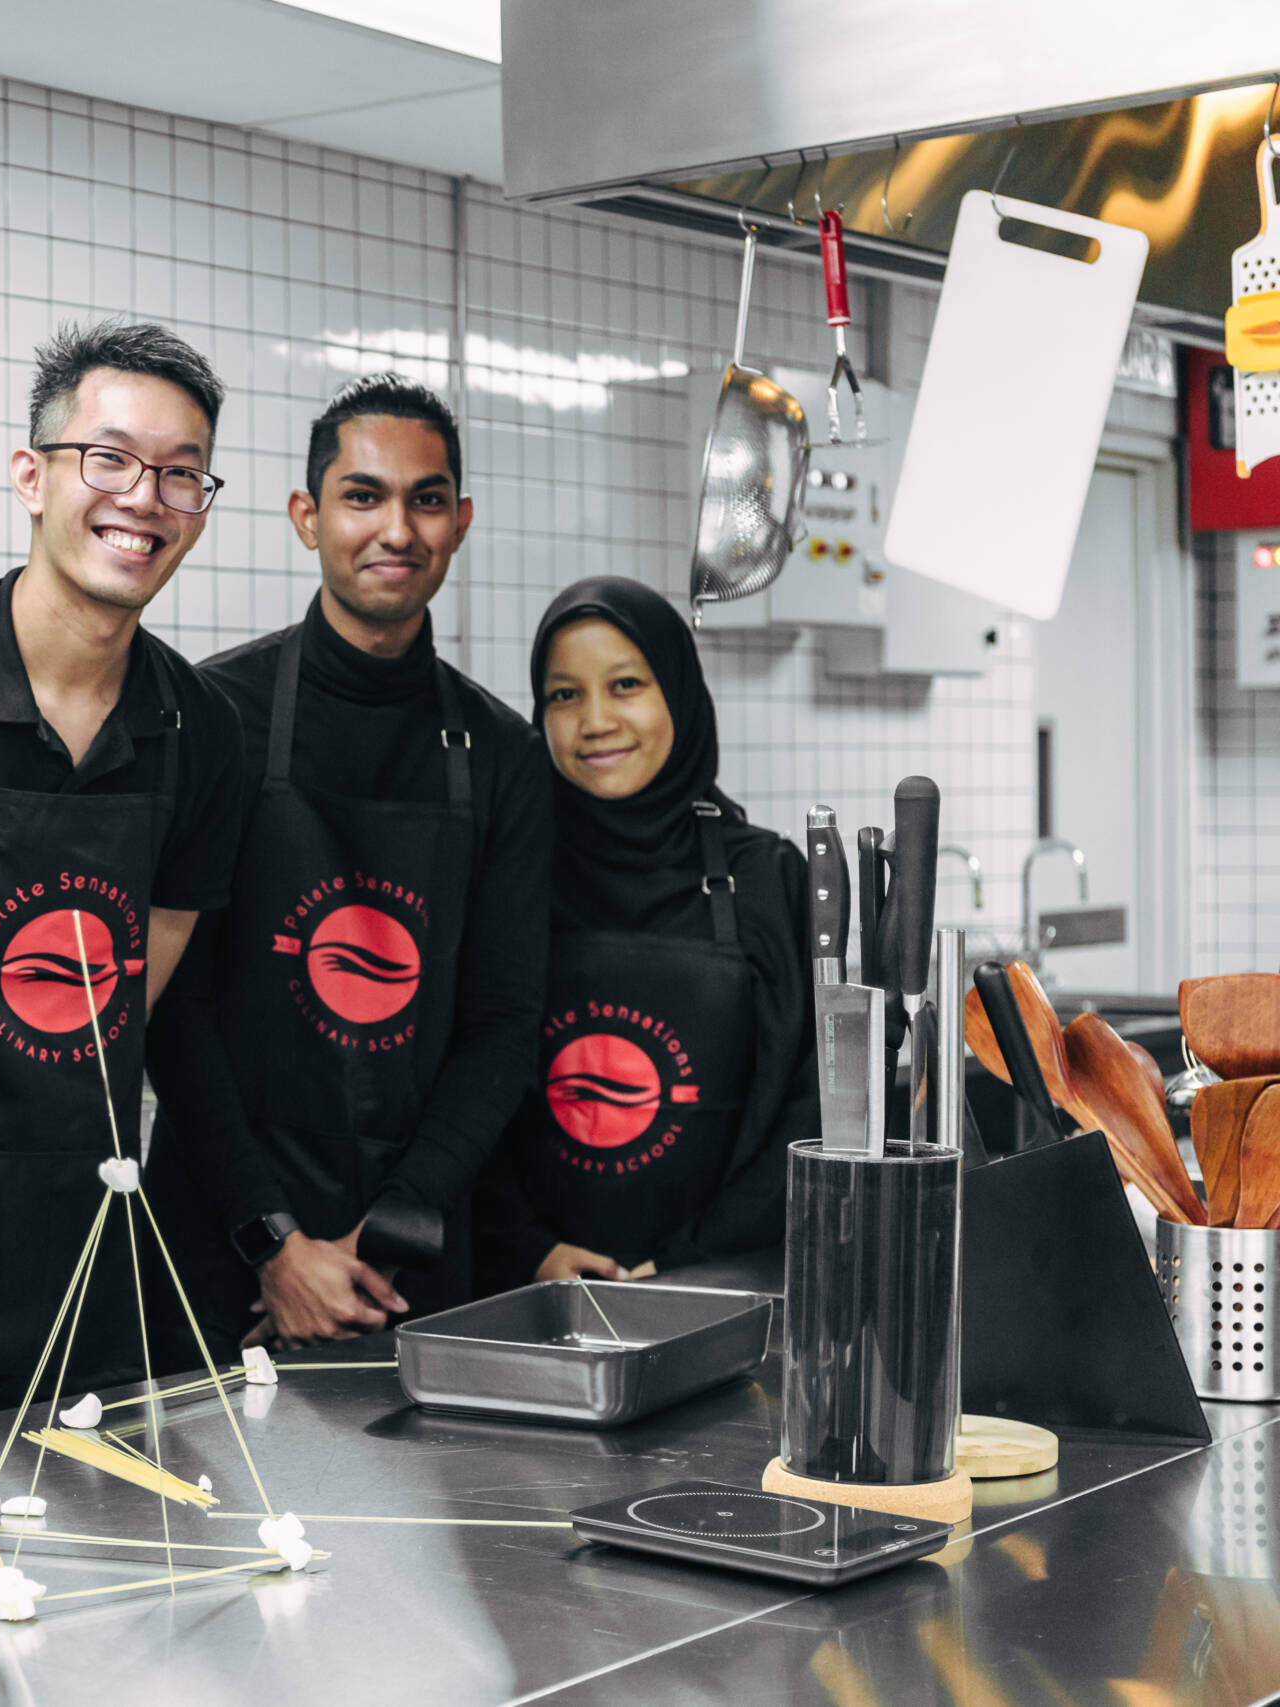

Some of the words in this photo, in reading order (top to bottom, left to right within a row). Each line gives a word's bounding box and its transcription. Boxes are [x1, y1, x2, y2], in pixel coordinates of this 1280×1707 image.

[59, 872, 140, 949] Sensations
[284, 876, 345, 930] Palate
[355, 870, 429, 928] Sensat
[588, 1000, 693, 1078] Sensations
